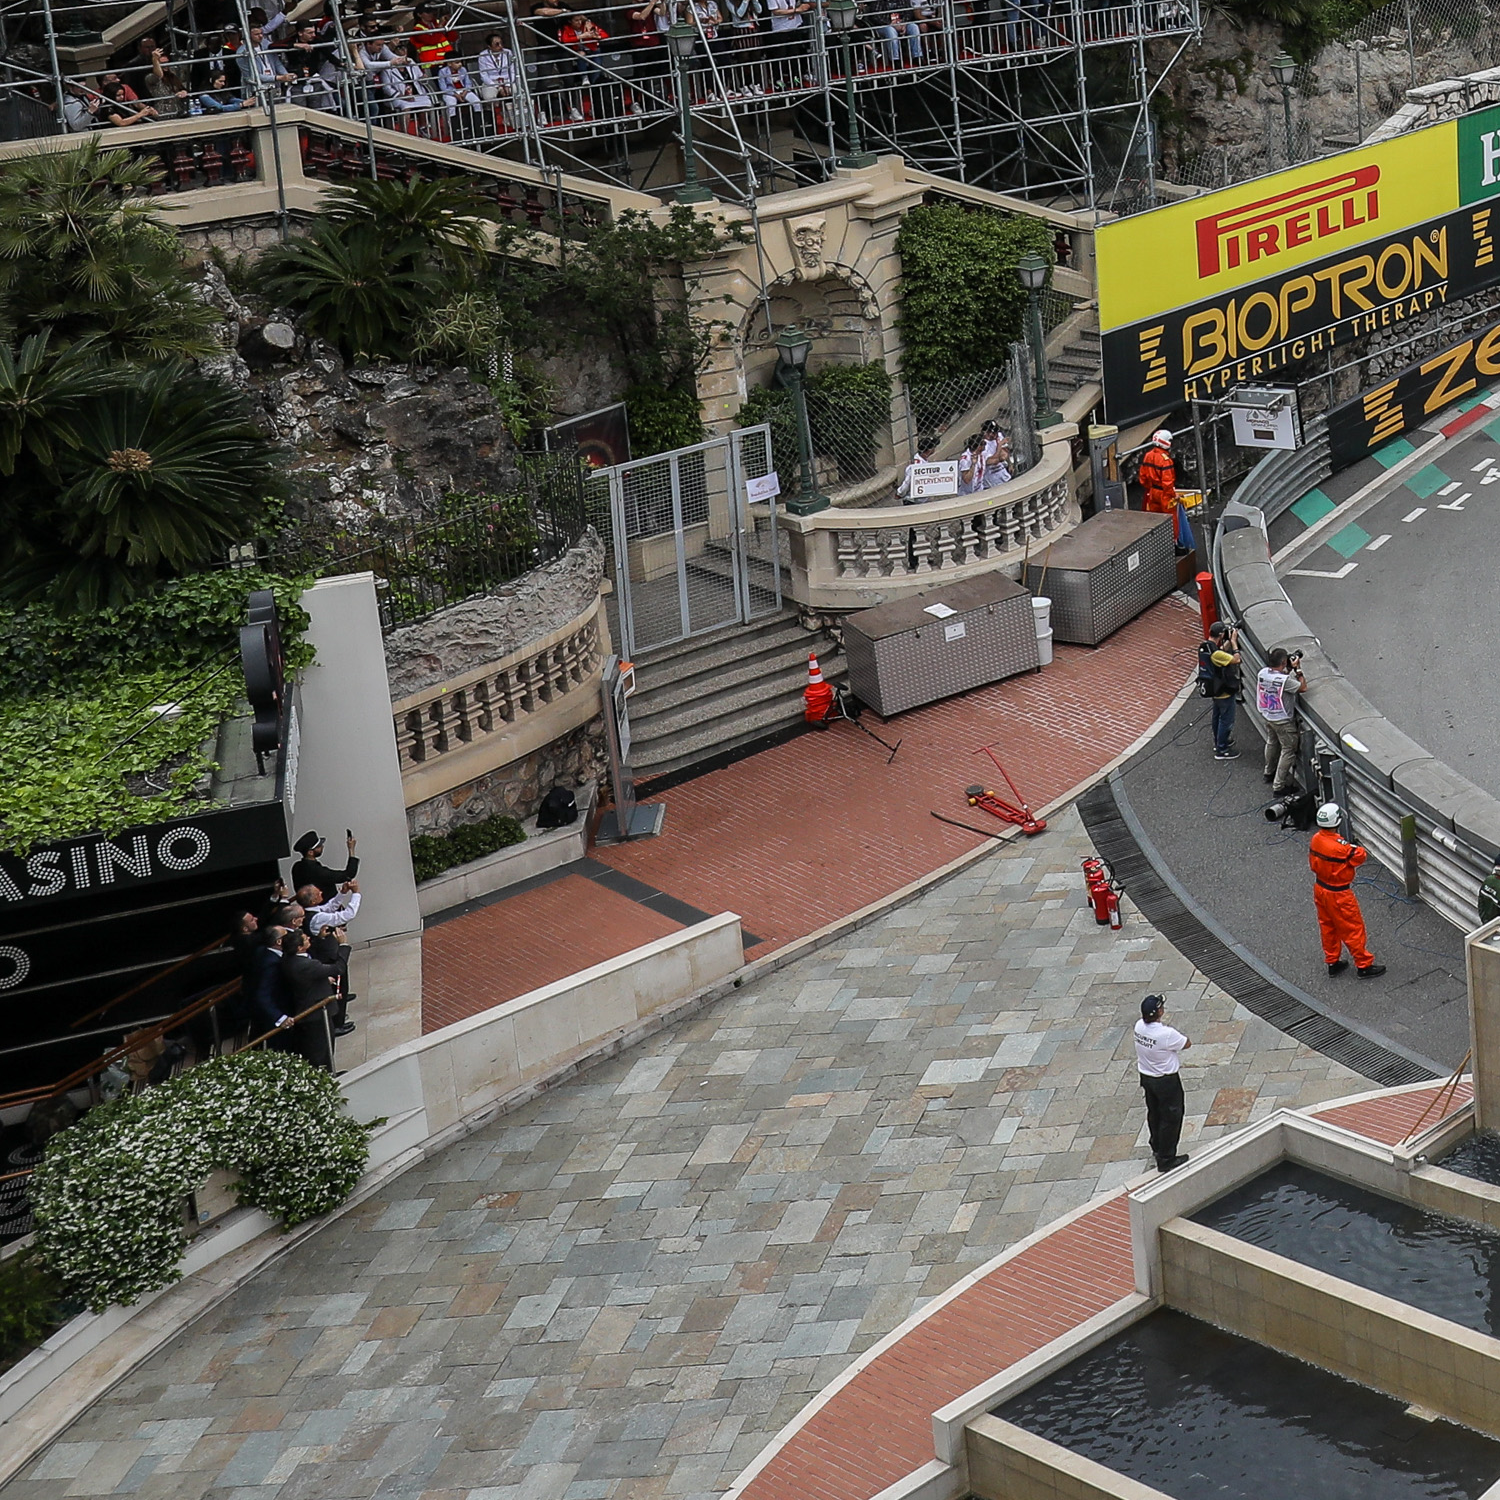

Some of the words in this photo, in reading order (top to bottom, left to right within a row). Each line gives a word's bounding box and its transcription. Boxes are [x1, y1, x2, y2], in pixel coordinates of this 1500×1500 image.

[1195, 164, 1381, 279] PIRELLI
[1182, 225, 1449, 377] BIOPTRON
[1183, 326, 1337, 402] HYPERLIGHT
[1351, 285, 1449, 337] THERAPY
[914, 466, 941, 476] SECTEUR
[948, 465, 954, 473] 6
[914, 476, 954, 486] INTERVENTION
[917, 485, 924, 495] 6
[0, 826, 212, 903] SINO
